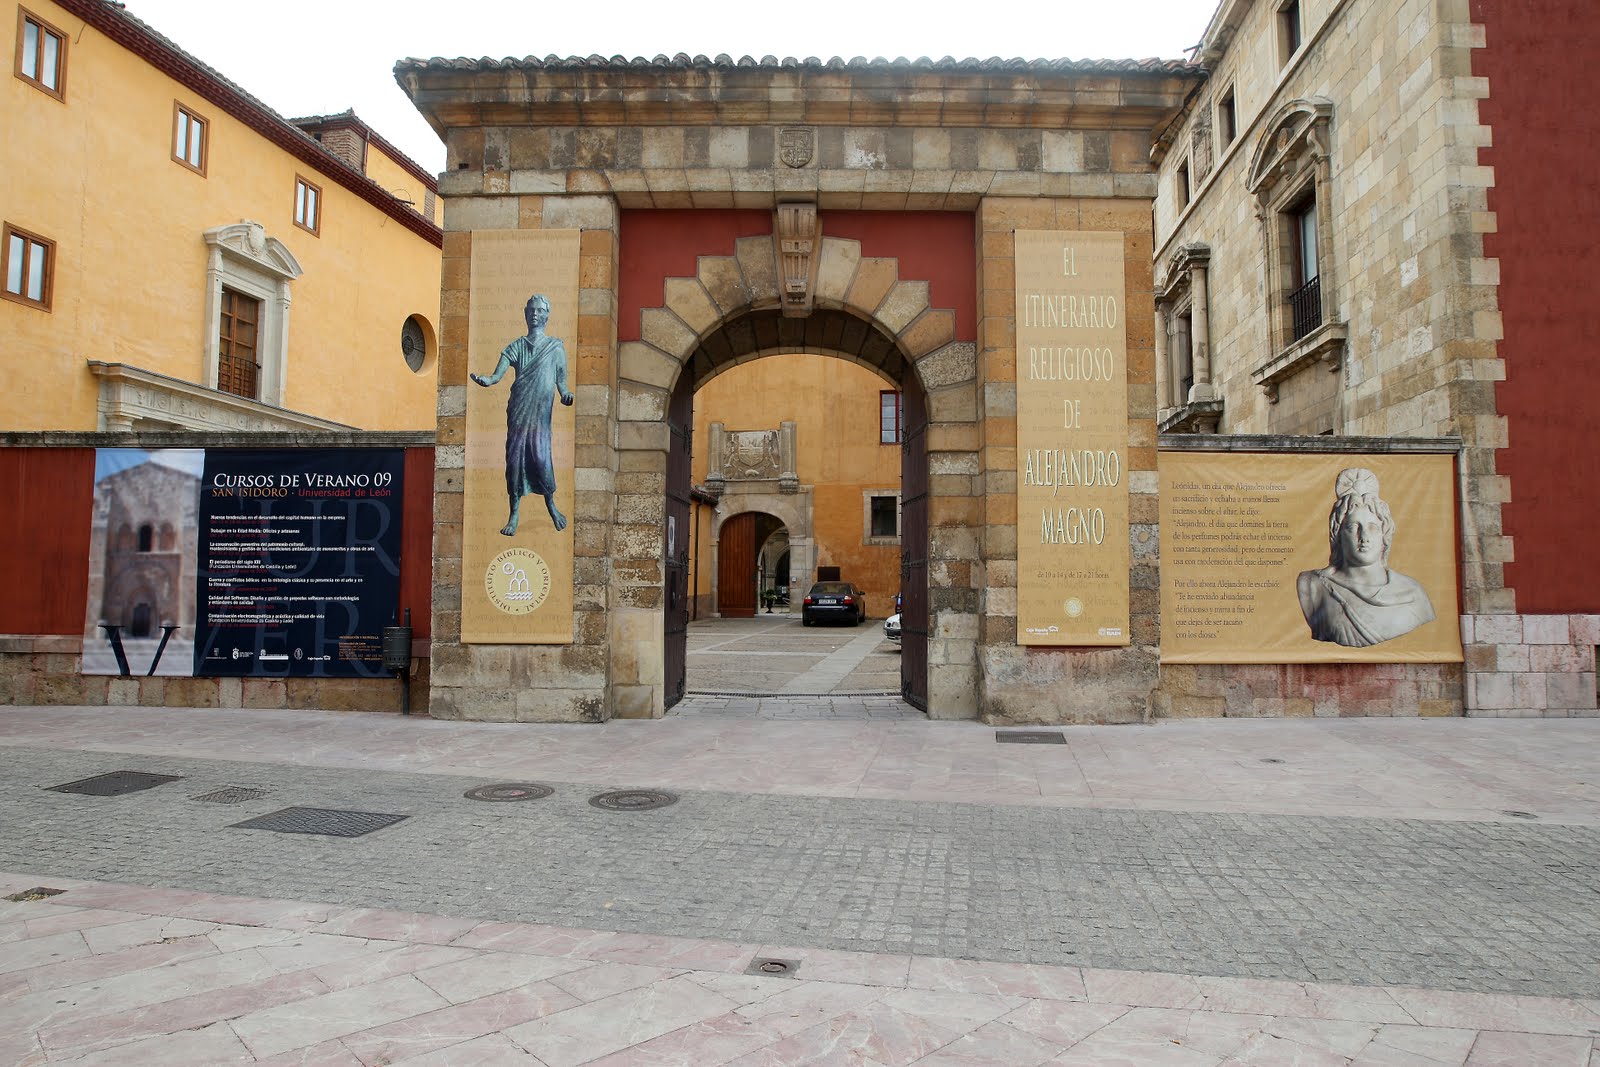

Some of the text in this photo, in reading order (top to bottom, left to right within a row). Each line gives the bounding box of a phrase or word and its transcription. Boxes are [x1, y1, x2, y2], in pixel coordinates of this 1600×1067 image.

[1064, 248, 1077, 276] EL
[1025, 295, 1117, 329] ITINERARIO
[1030, 347, 1114, 381] RELIGIOSO
[1064, 399, 1081, 429] DE
[214, 472, 392, 487] CURSOS DE VERANO 09
[1024, 449, 1121, 497] ALEJANDRO
[212, 488, 391, 497] SAN ISIDORO Universidad de León
[1041, 507, 1105, 545] MAGNO
[497, 549, 535, 563] BÍBLICO
[487, 564, 512, 612] INSTITUTO
